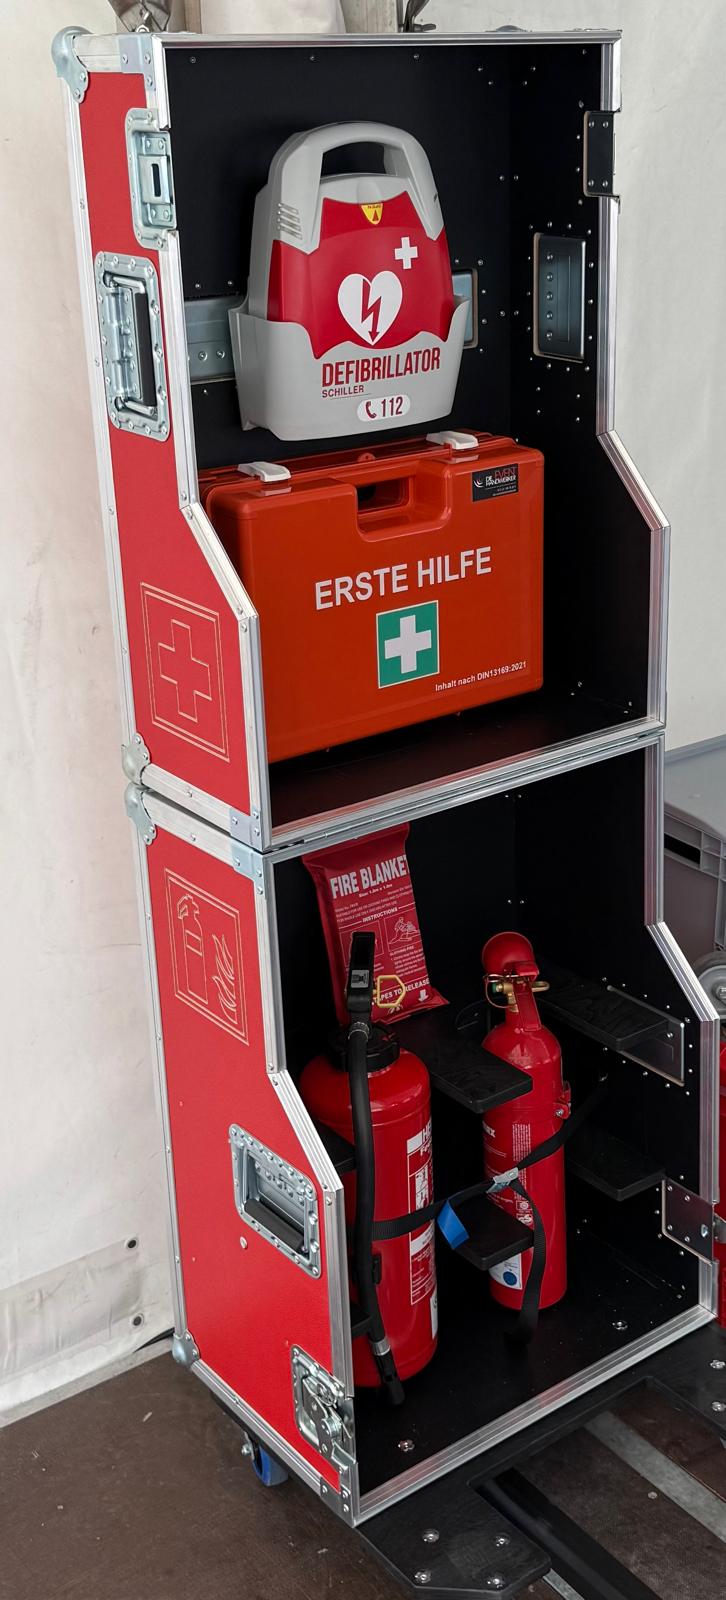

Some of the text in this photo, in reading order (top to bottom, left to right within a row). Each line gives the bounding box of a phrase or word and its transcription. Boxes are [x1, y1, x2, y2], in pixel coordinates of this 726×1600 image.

[321, 347, 441, 388] DEFIBRILLATOR
[321, 385, 365, 398] SCHILLER
[381, 396, 404, 417] 112
[494, 466, 517, 480] EVENT
[315, 546, 493, 611] ERSTE HILFE
[435, 660, 527, 692] Inhalt nach DIN13169:2021
[329, 871, 360, 900] FIRE
[362, 906, 399, 923] INSTRUCTIONS
[372, 991, 393, 1003] TPES
